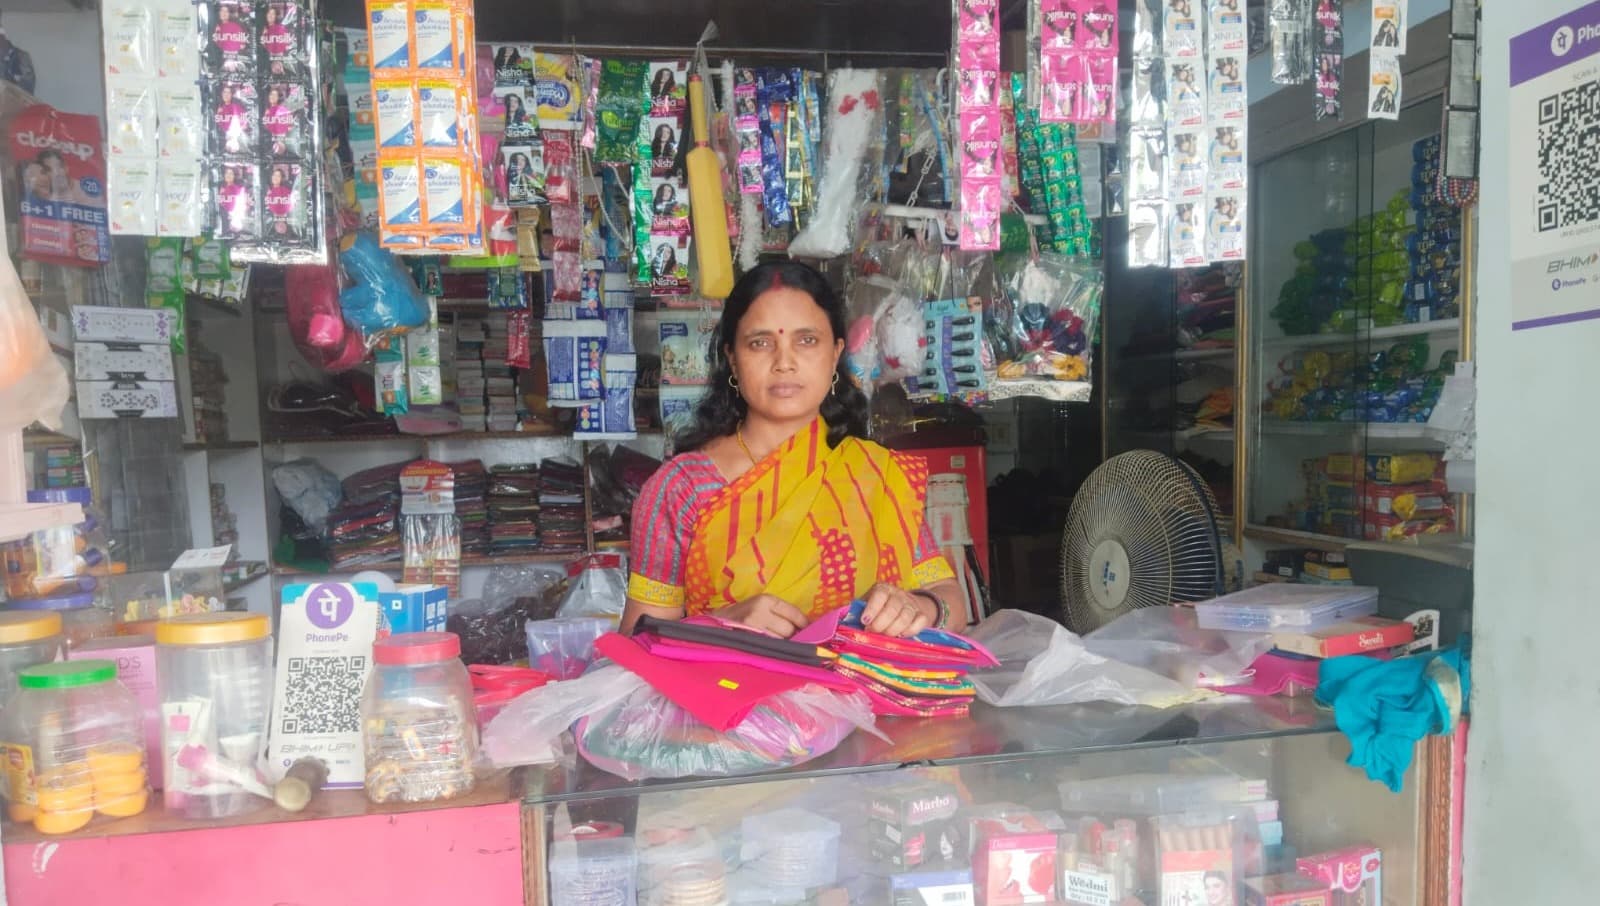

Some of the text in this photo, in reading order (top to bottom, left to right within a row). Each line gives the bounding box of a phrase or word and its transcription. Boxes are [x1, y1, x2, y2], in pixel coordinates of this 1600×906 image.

[212, 31, 250, 43] sunsilk
[260, 32, 297, 44] sunsilk
[262, 114, 298, 126] sunsilk
[61, 205, 105, 224] FREE
[1546, 255, 1591, 273] BHIM
[653, 277, 678, 287] Nisha
[317, 588, 341, 622] पे
[305, 632, 349, 643] PhonePe
[911, 795, 950, 815] Marbo
